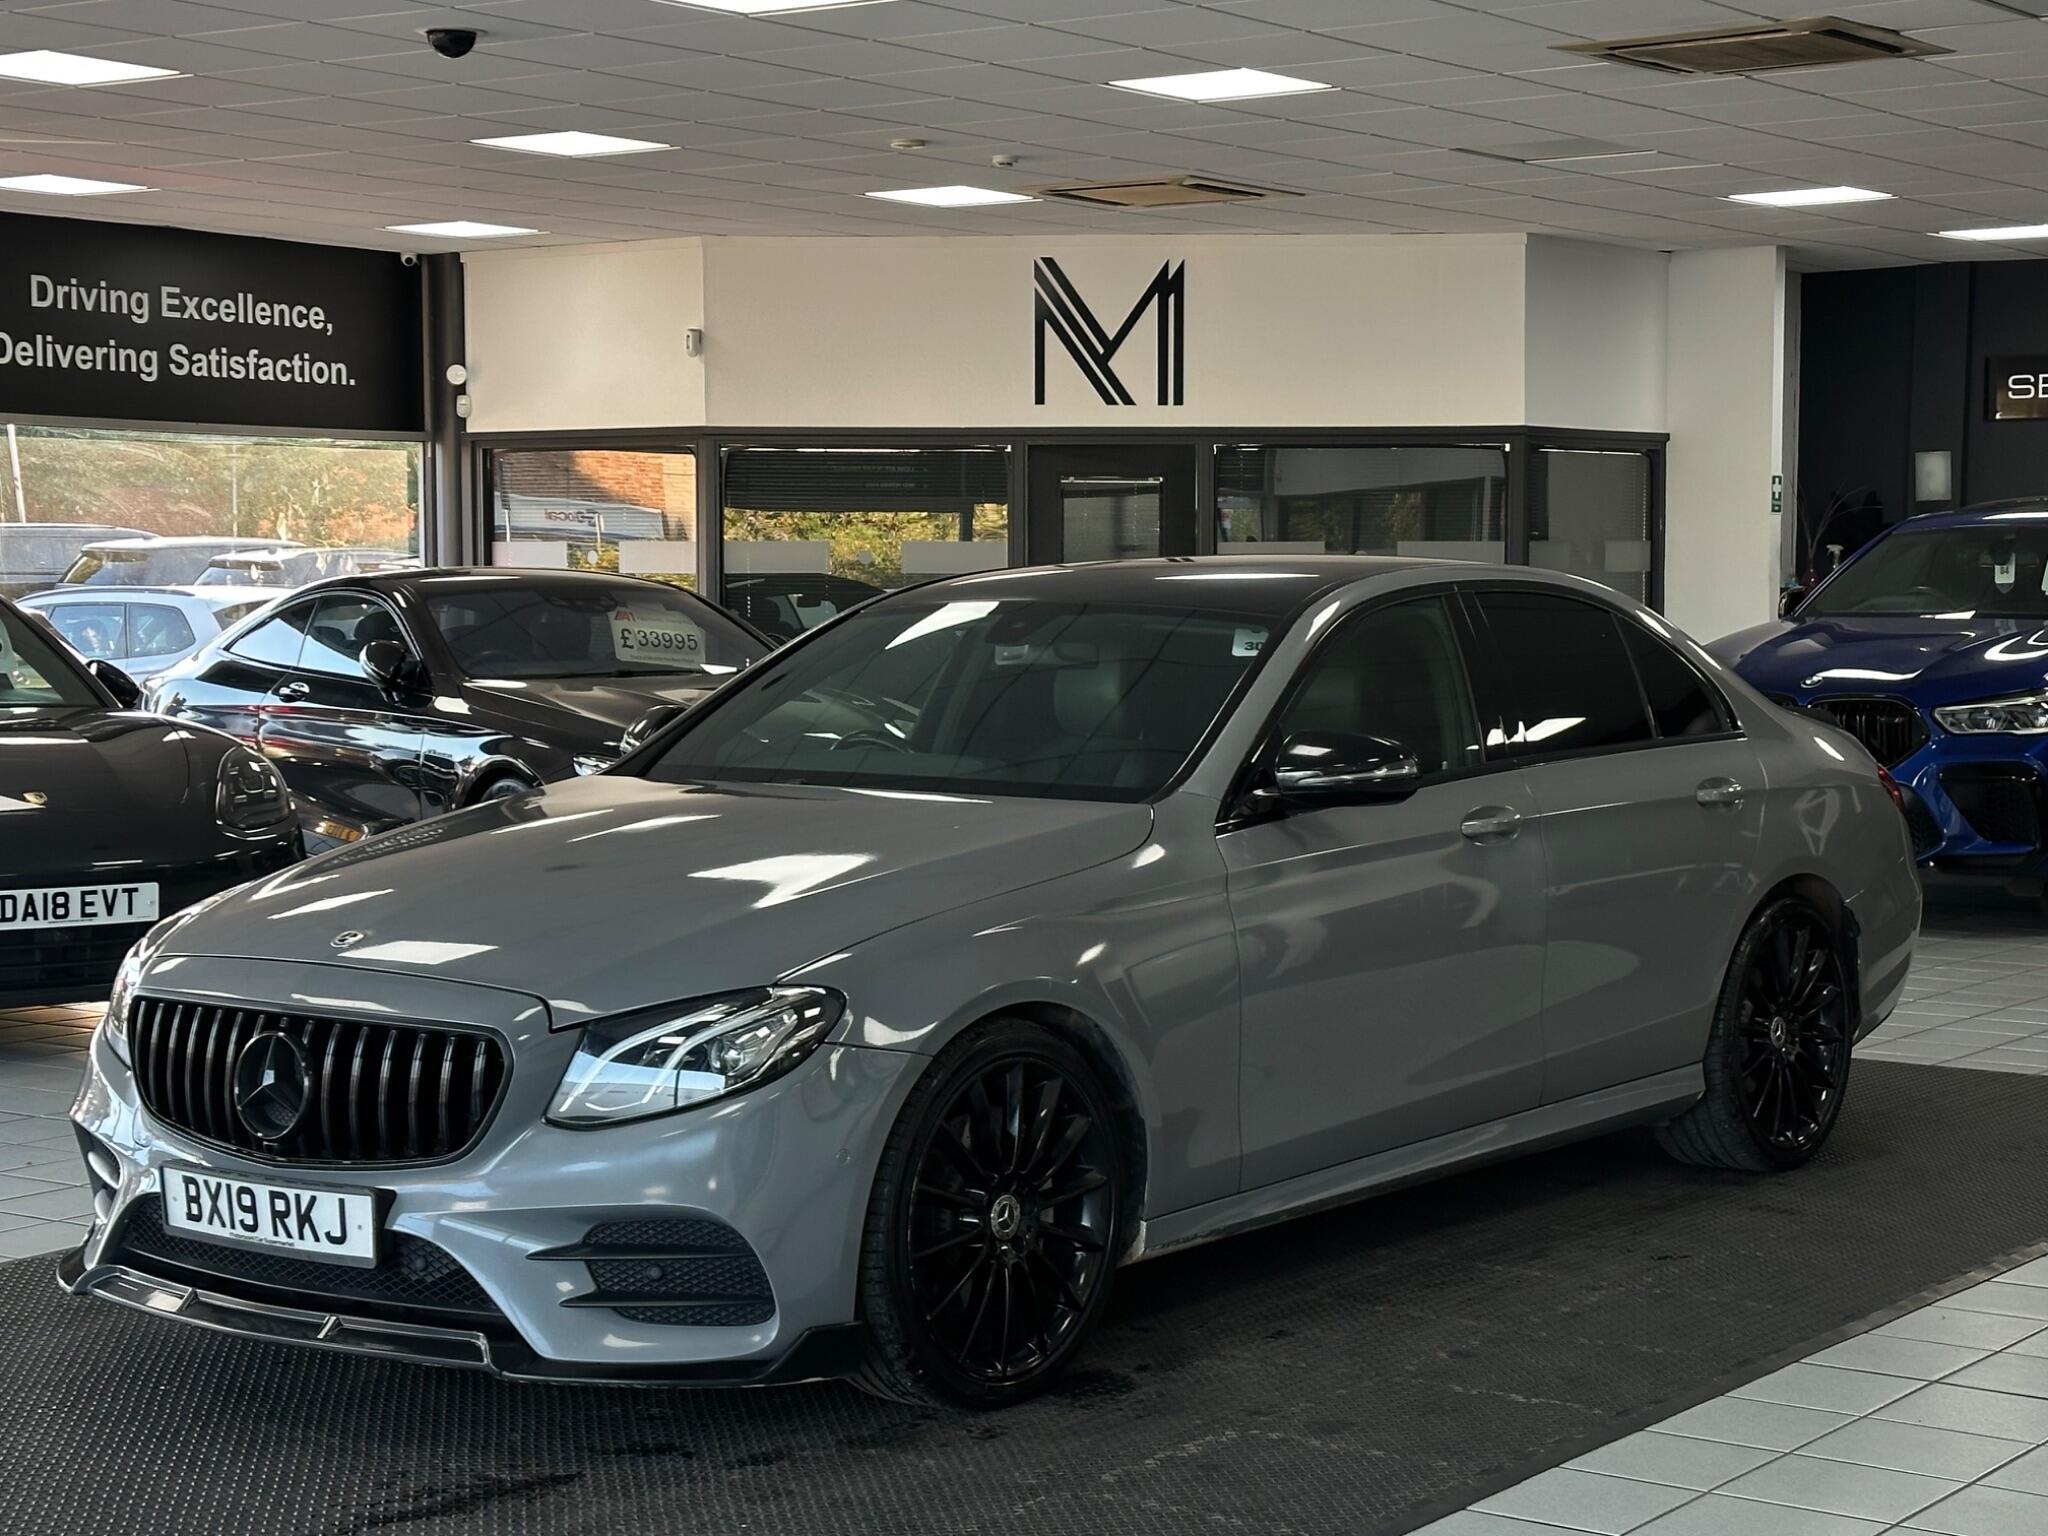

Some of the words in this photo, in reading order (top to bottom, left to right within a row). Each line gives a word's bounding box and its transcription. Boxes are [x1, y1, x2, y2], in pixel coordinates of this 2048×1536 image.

[30, 274, 149, 324] Driving
[160, 286, 333, 336] Excellence,
[0, 331, 158, 382] Delivering
[168, 343, 356, 386] Satisfaction.
[620, 628, 698, 650] £33995
[0, 890, 70, 922] DA18
[80, 887, 139, 918] EVT
[182, 1175, 259, 1233] BX19
[269, 1190, 347, 1246] RKJ
